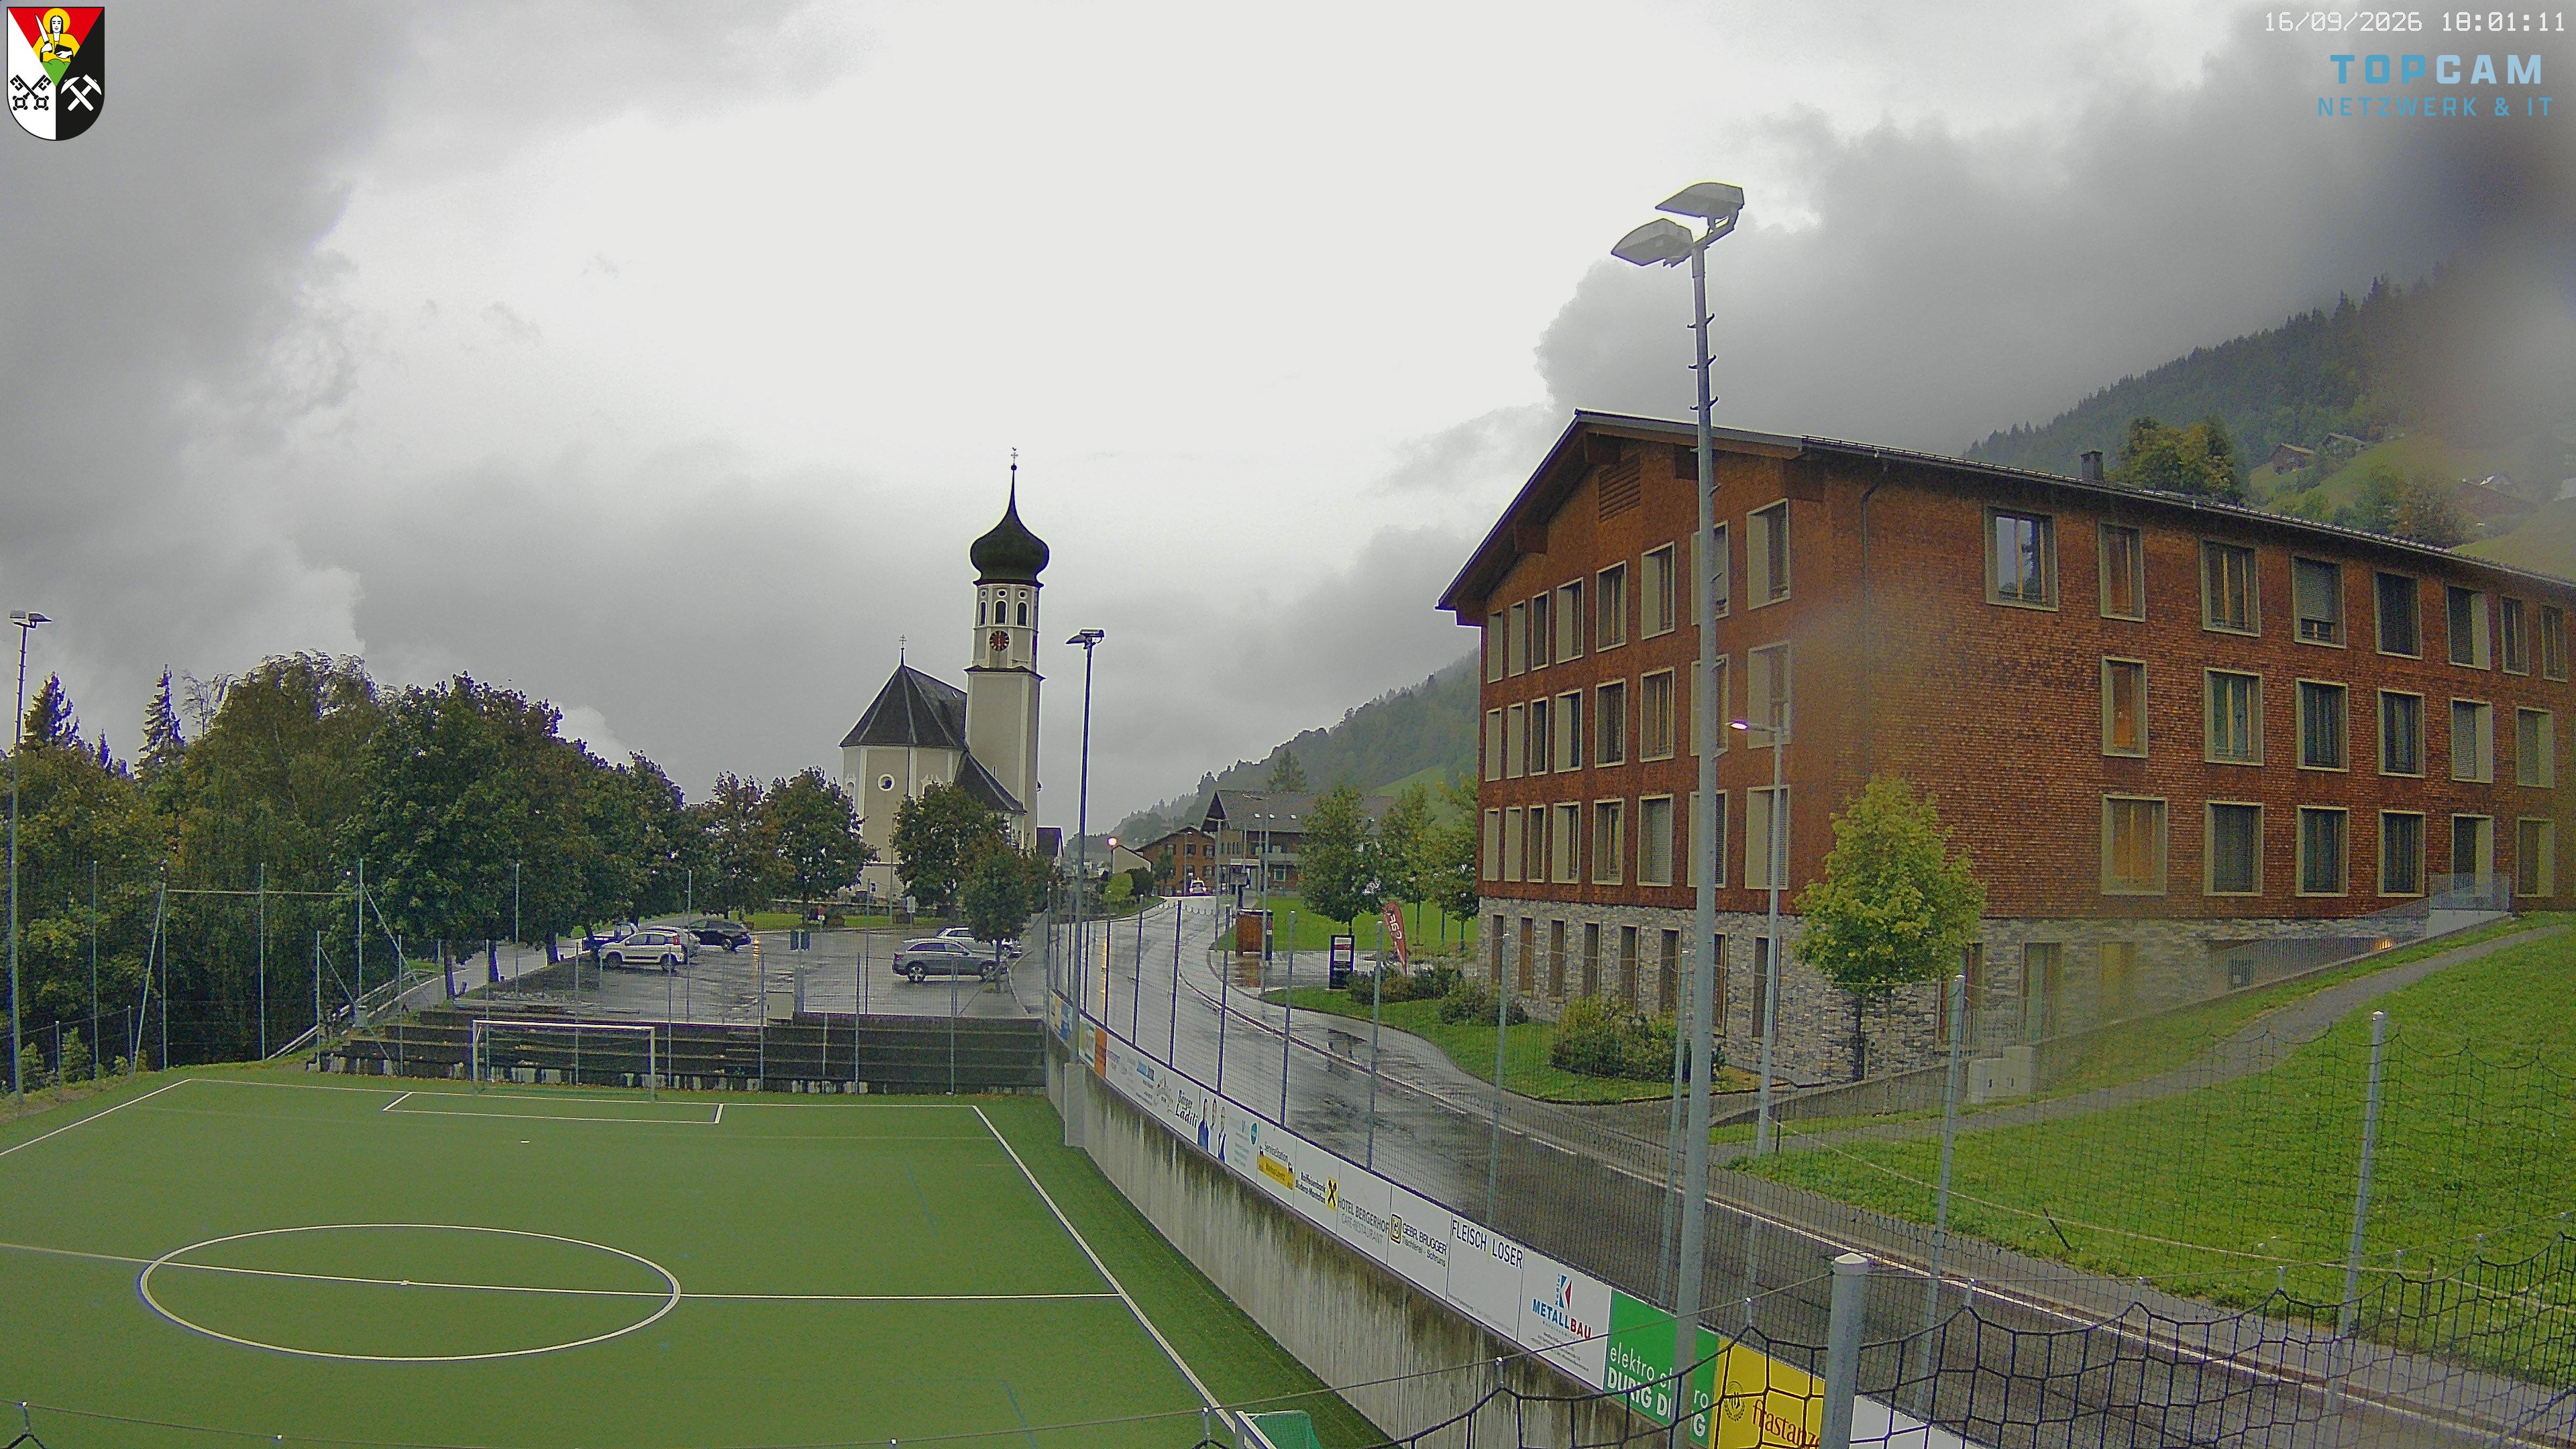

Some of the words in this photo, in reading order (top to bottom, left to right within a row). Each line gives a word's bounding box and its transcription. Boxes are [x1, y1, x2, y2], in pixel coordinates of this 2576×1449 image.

[1301, 1171, 1326, 1193] Raiffeisenbank
[1338, 1197, 1354, 1215] HOTEL
[1355, 1205, 1390, 1234] BERGERHOF
[1402, 1222, 1418, 1241] GEBR.
[1419, 1231, 1447, 1256] BRUGGER
[1402, 1235, 1423, 1254] Tischlerei
[1426, 1248, 1446, 1267] Schruns
[1452, 1219, 1487, 1252] FLEISCH
[1492, 1238, 1523, 1269] LOSER
[1532, 1298, 1592, 1340] METALLBAU
[1607, 1366, 1652, 1409] DURIG
[1610, 1342, 1655, 1381] elektro
[1659, 1366, 1709, 1409] elro
